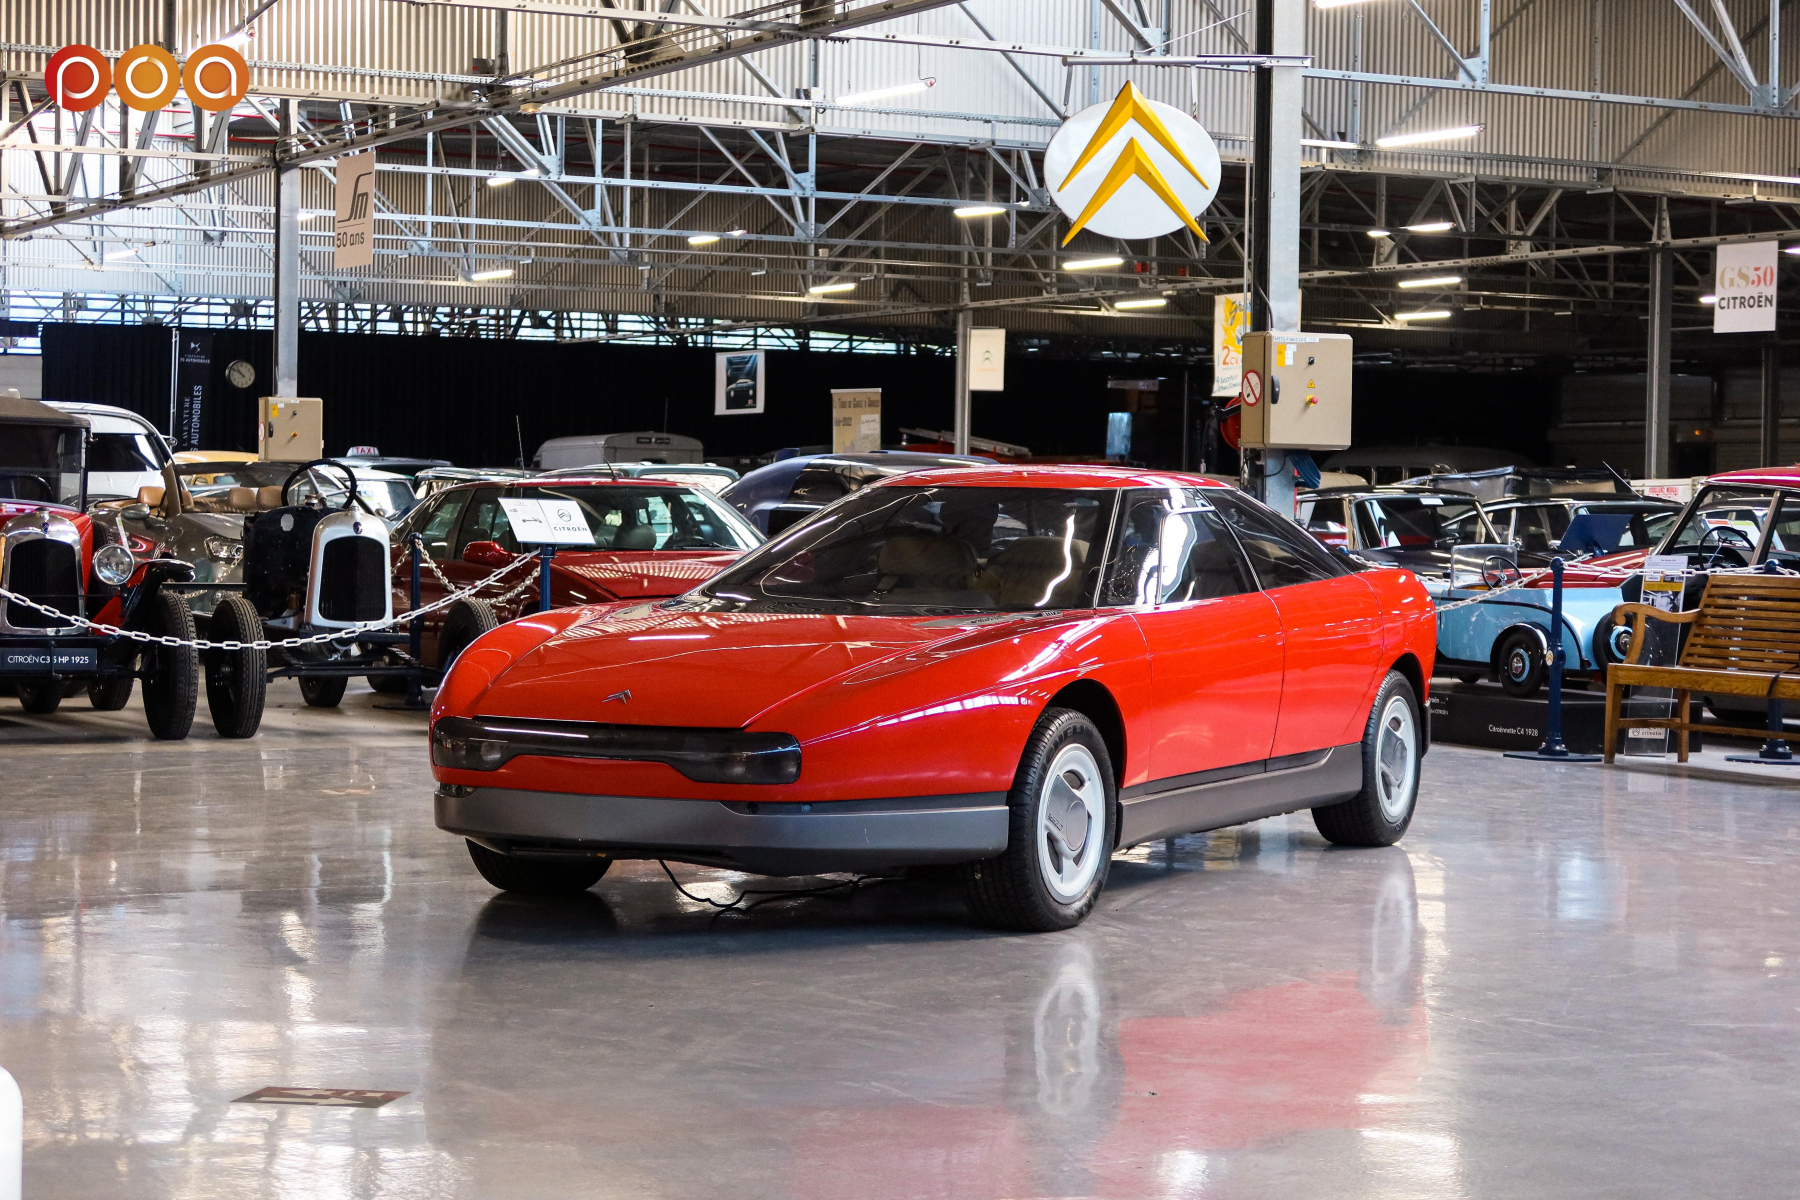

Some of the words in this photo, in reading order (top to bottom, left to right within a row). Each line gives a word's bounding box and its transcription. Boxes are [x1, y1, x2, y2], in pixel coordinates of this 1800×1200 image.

[336, 232, 348, 249] 50
[350, 231, 365, 247] ans
[1718, 292, 1774, 310] CITROËN
[190, 385, 203, 445] AUTOMOBILES
[354, 446, 376, 455] TAXI
[7, 654, 39, 664] CITROËN
[40, 655, 51, 664] C3
[58, 656, 69, 664] HP
[71, 656, 89, 664] 1925
[1488, 724, 1517, 735] Citroënnette
[1525, 728, 1539, 737] 1928
